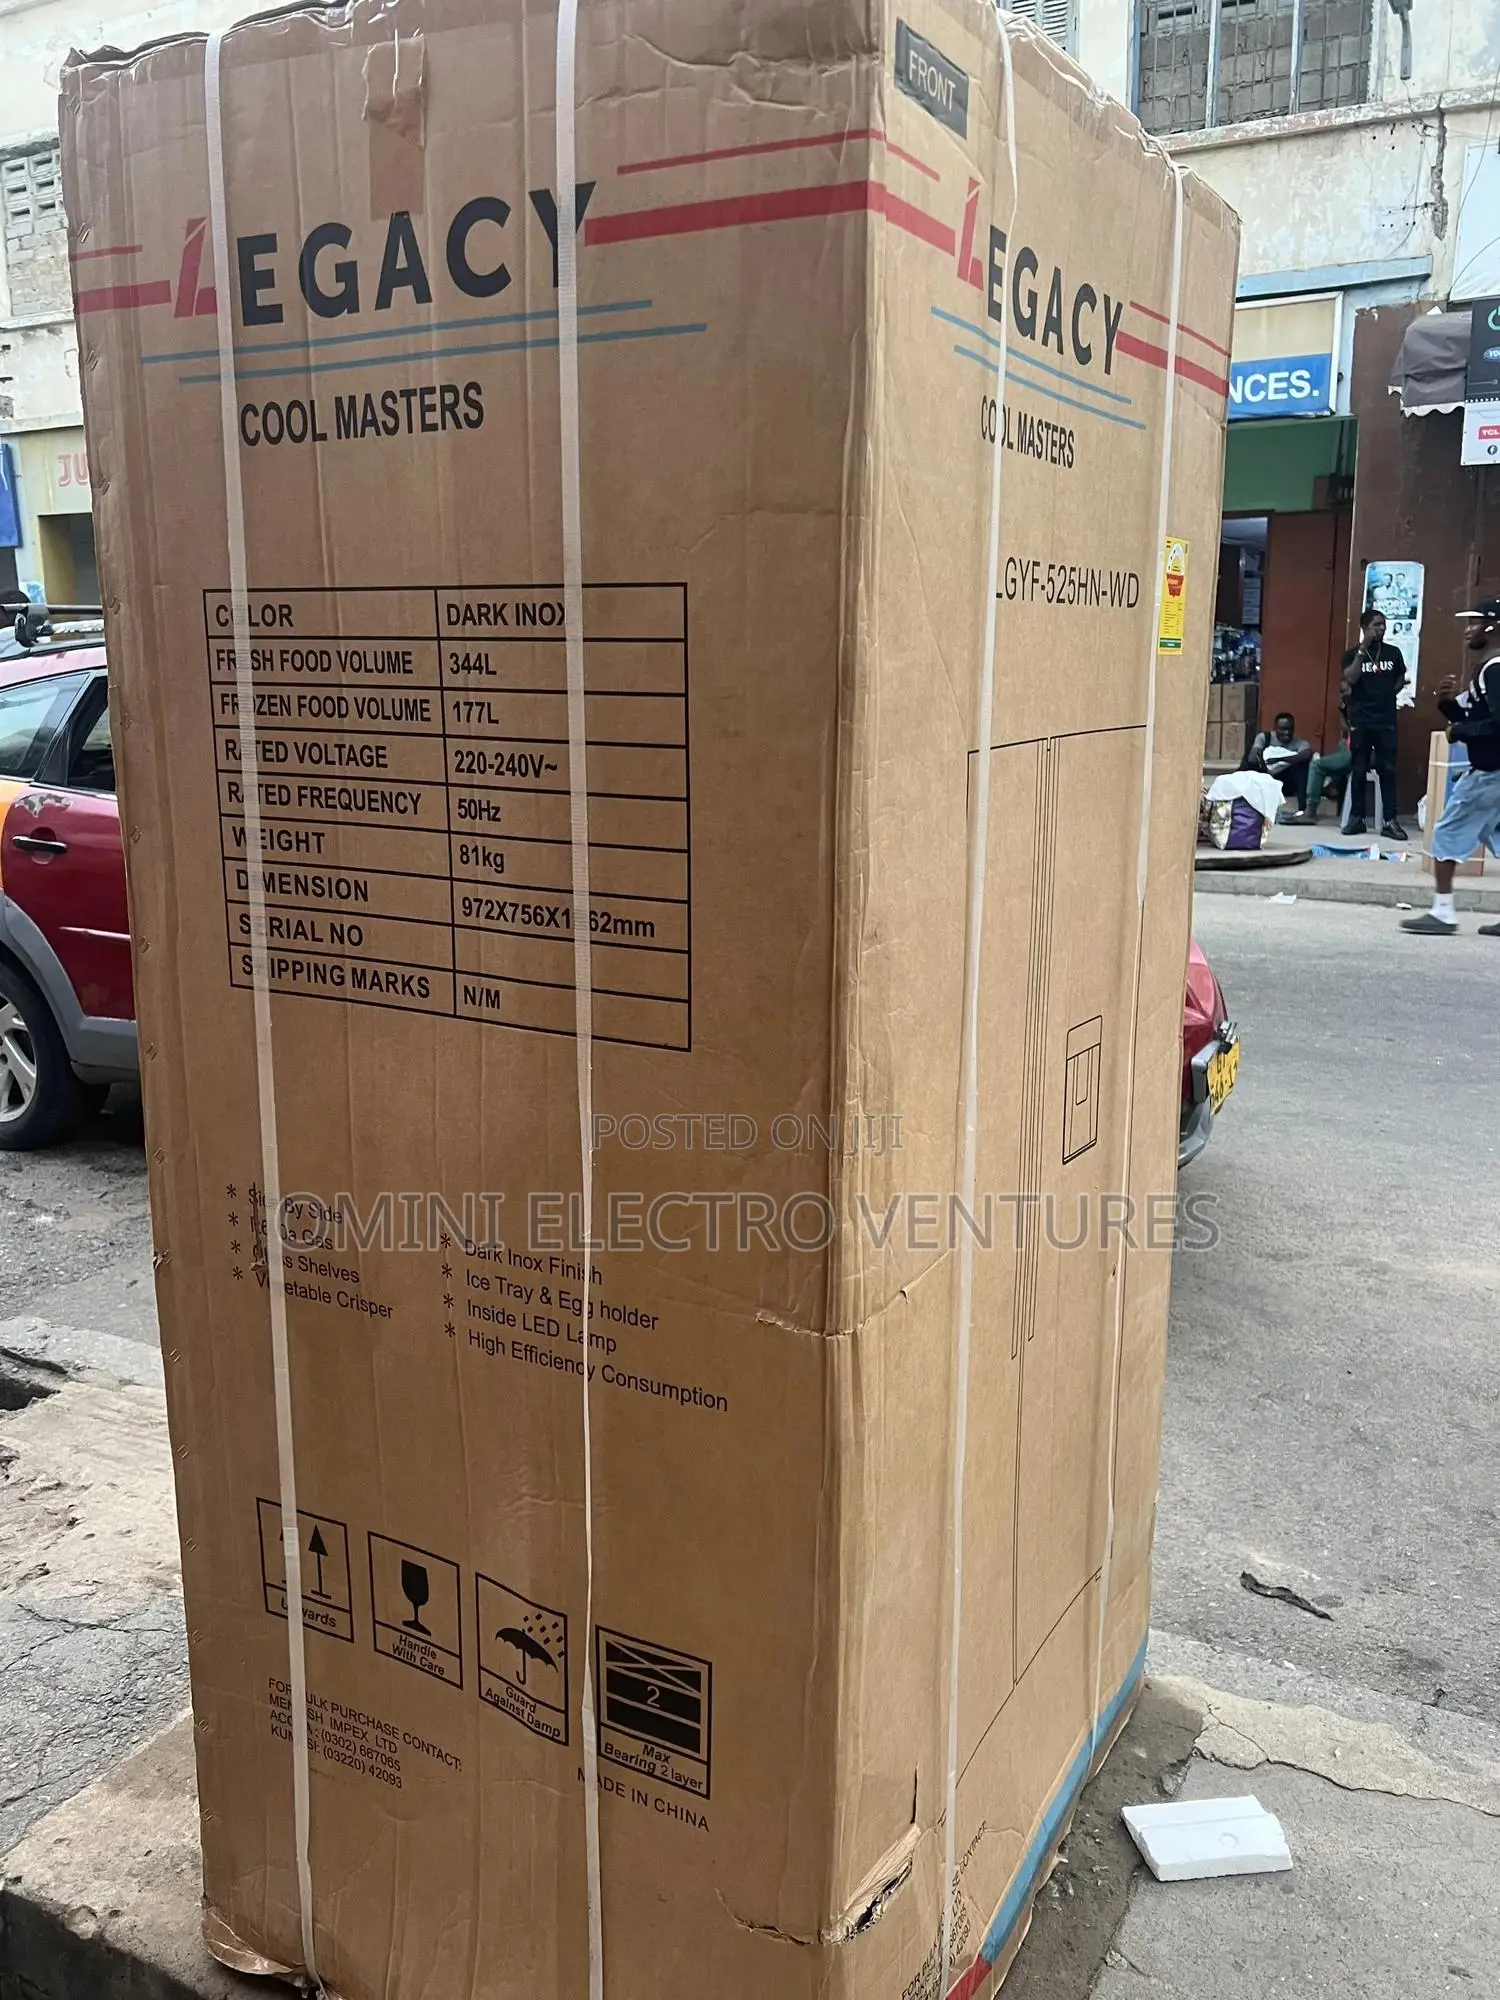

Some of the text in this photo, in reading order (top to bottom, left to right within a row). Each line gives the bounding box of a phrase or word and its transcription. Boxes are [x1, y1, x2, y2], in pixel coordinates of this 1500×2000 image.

[908, 48, 957, 112] FRONT
[173, 180, 597, 327] LEGACY
[956, 176, 1124, 376] LEGACY
[239, 380, 485, 448] COOL MASTERS
[1016, 410, 1075, 469] MASTERS
[996, 556, 1140, 609] GYF-525HN-WD
[215, 603, 295, 628] CLOR
[446, 602, 509, 627] DARK
[215, 648, 414, 675] FRSH FOOD VOLUME
[449, 652, 497, 676] 344L
[220, 693, 432, 722] FRZEN FOOD VOLUME
[452, 701, 500, 725] 177L
[224, 738, 389, 769] RTED VOLTAGE
[297, 784, 422, 816] FREQUENCY
[457, 798, 502, 823] 50Hz
[459, 843, 505, 875] 81kg
[235, 868, 369, 902] DMENSION
[239, 912, 364, 947] SRIAL NO
[461, 896, 656, 938] 972X756X162mm
[241, 953, 431, 999] SIPPING MARKS
[463, 984, 501, 1010] N/M
[285, 1198, 304, 1221] By
[309, 1201, 343, 1225] Side
[302, 1228, 334, 1251] Gas
[464, 1239, 503, 1265] Dark
[508, 1249, 544, 1273] Inox
[298, 1255, 360, 1285] Shelves
[255, 1271, 394, 1319] Vetable Crisper
[466, 1268, 491, 1292] Ice
[495, 1275, 534, 1305] Tray
[539, 1286, 552, 1306] &
[600, 1300, 659, 1331] holder
[467, 1299, 517, 1328] Inside
[522, 1314, 560, 1338] LED
[468, 1328, 728, 1412] High Efficiency Consumption
[392, 1643, 445, 1677] With Care
[398, 1634, 438, 1661] Handle
[484, 1687, 562, 1740] Against Damp
[505, 1685, 537, 1715] Guard
[646, 1685, 661, 1708] 2
[305, 1690, 329, 1712] ULK
[330, 1701, 400, 1741] PURCHASE
[402, 1731, 463, 1773] CONTACT:
[329, 1716, 369, 1743] IMPEX
[374, 1736, 398, 1755] LTD
[321, 1728, 357, 1758] (0302)
[359, 1743, 401, 1773] 667065
[323, 1744, 366, 1776] (03220)
[368, 1765, 402, 1790] 42093
[603, 1741, 704, 1792] Bearing 2 layer
[641, 1743, 671, 1765] Max
[631, 1787, 648, 1808] IN
[653, 1797, 711, 1833] CHINA
